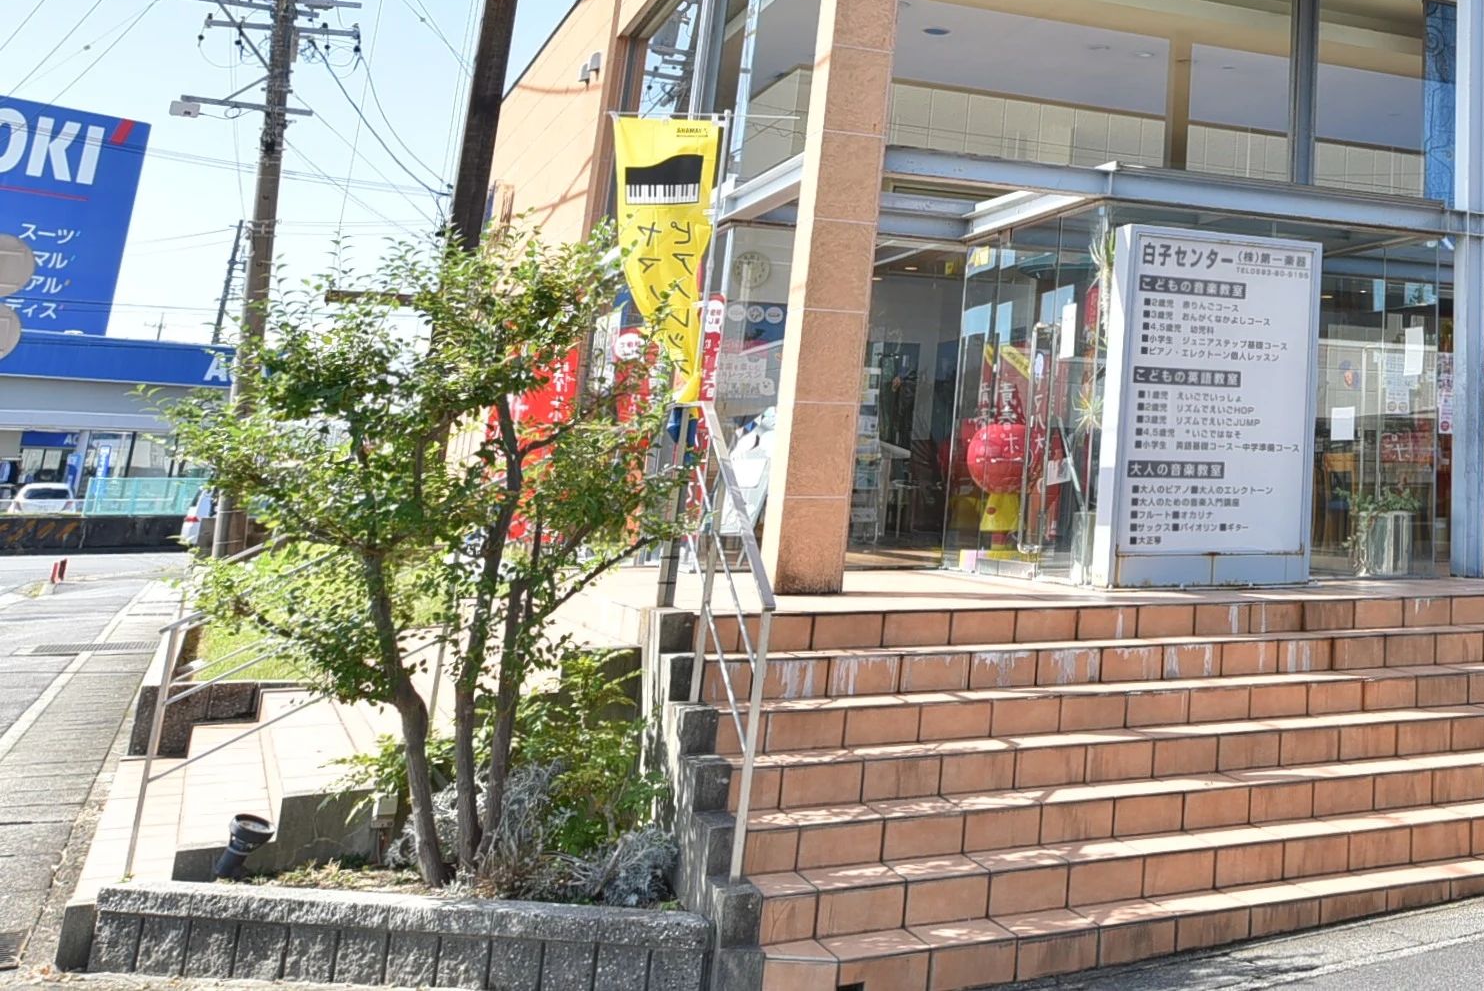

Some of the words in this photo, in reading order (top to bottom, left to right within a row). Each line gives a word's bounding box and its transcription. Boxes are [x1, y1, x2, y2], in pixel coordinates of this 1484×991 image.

[18, 223, 75, 244] スーツ
[1142, 242, 1234, 269] 白子センター
[1142, 278, 1244, 296] こどもの音楽教室
[1135, 369, 1240, 386] こどもの英語教室
[1185, 429, 1242, 438] いごではなそ
[1130, 463, 1222, 477] 大人の音楽教室
